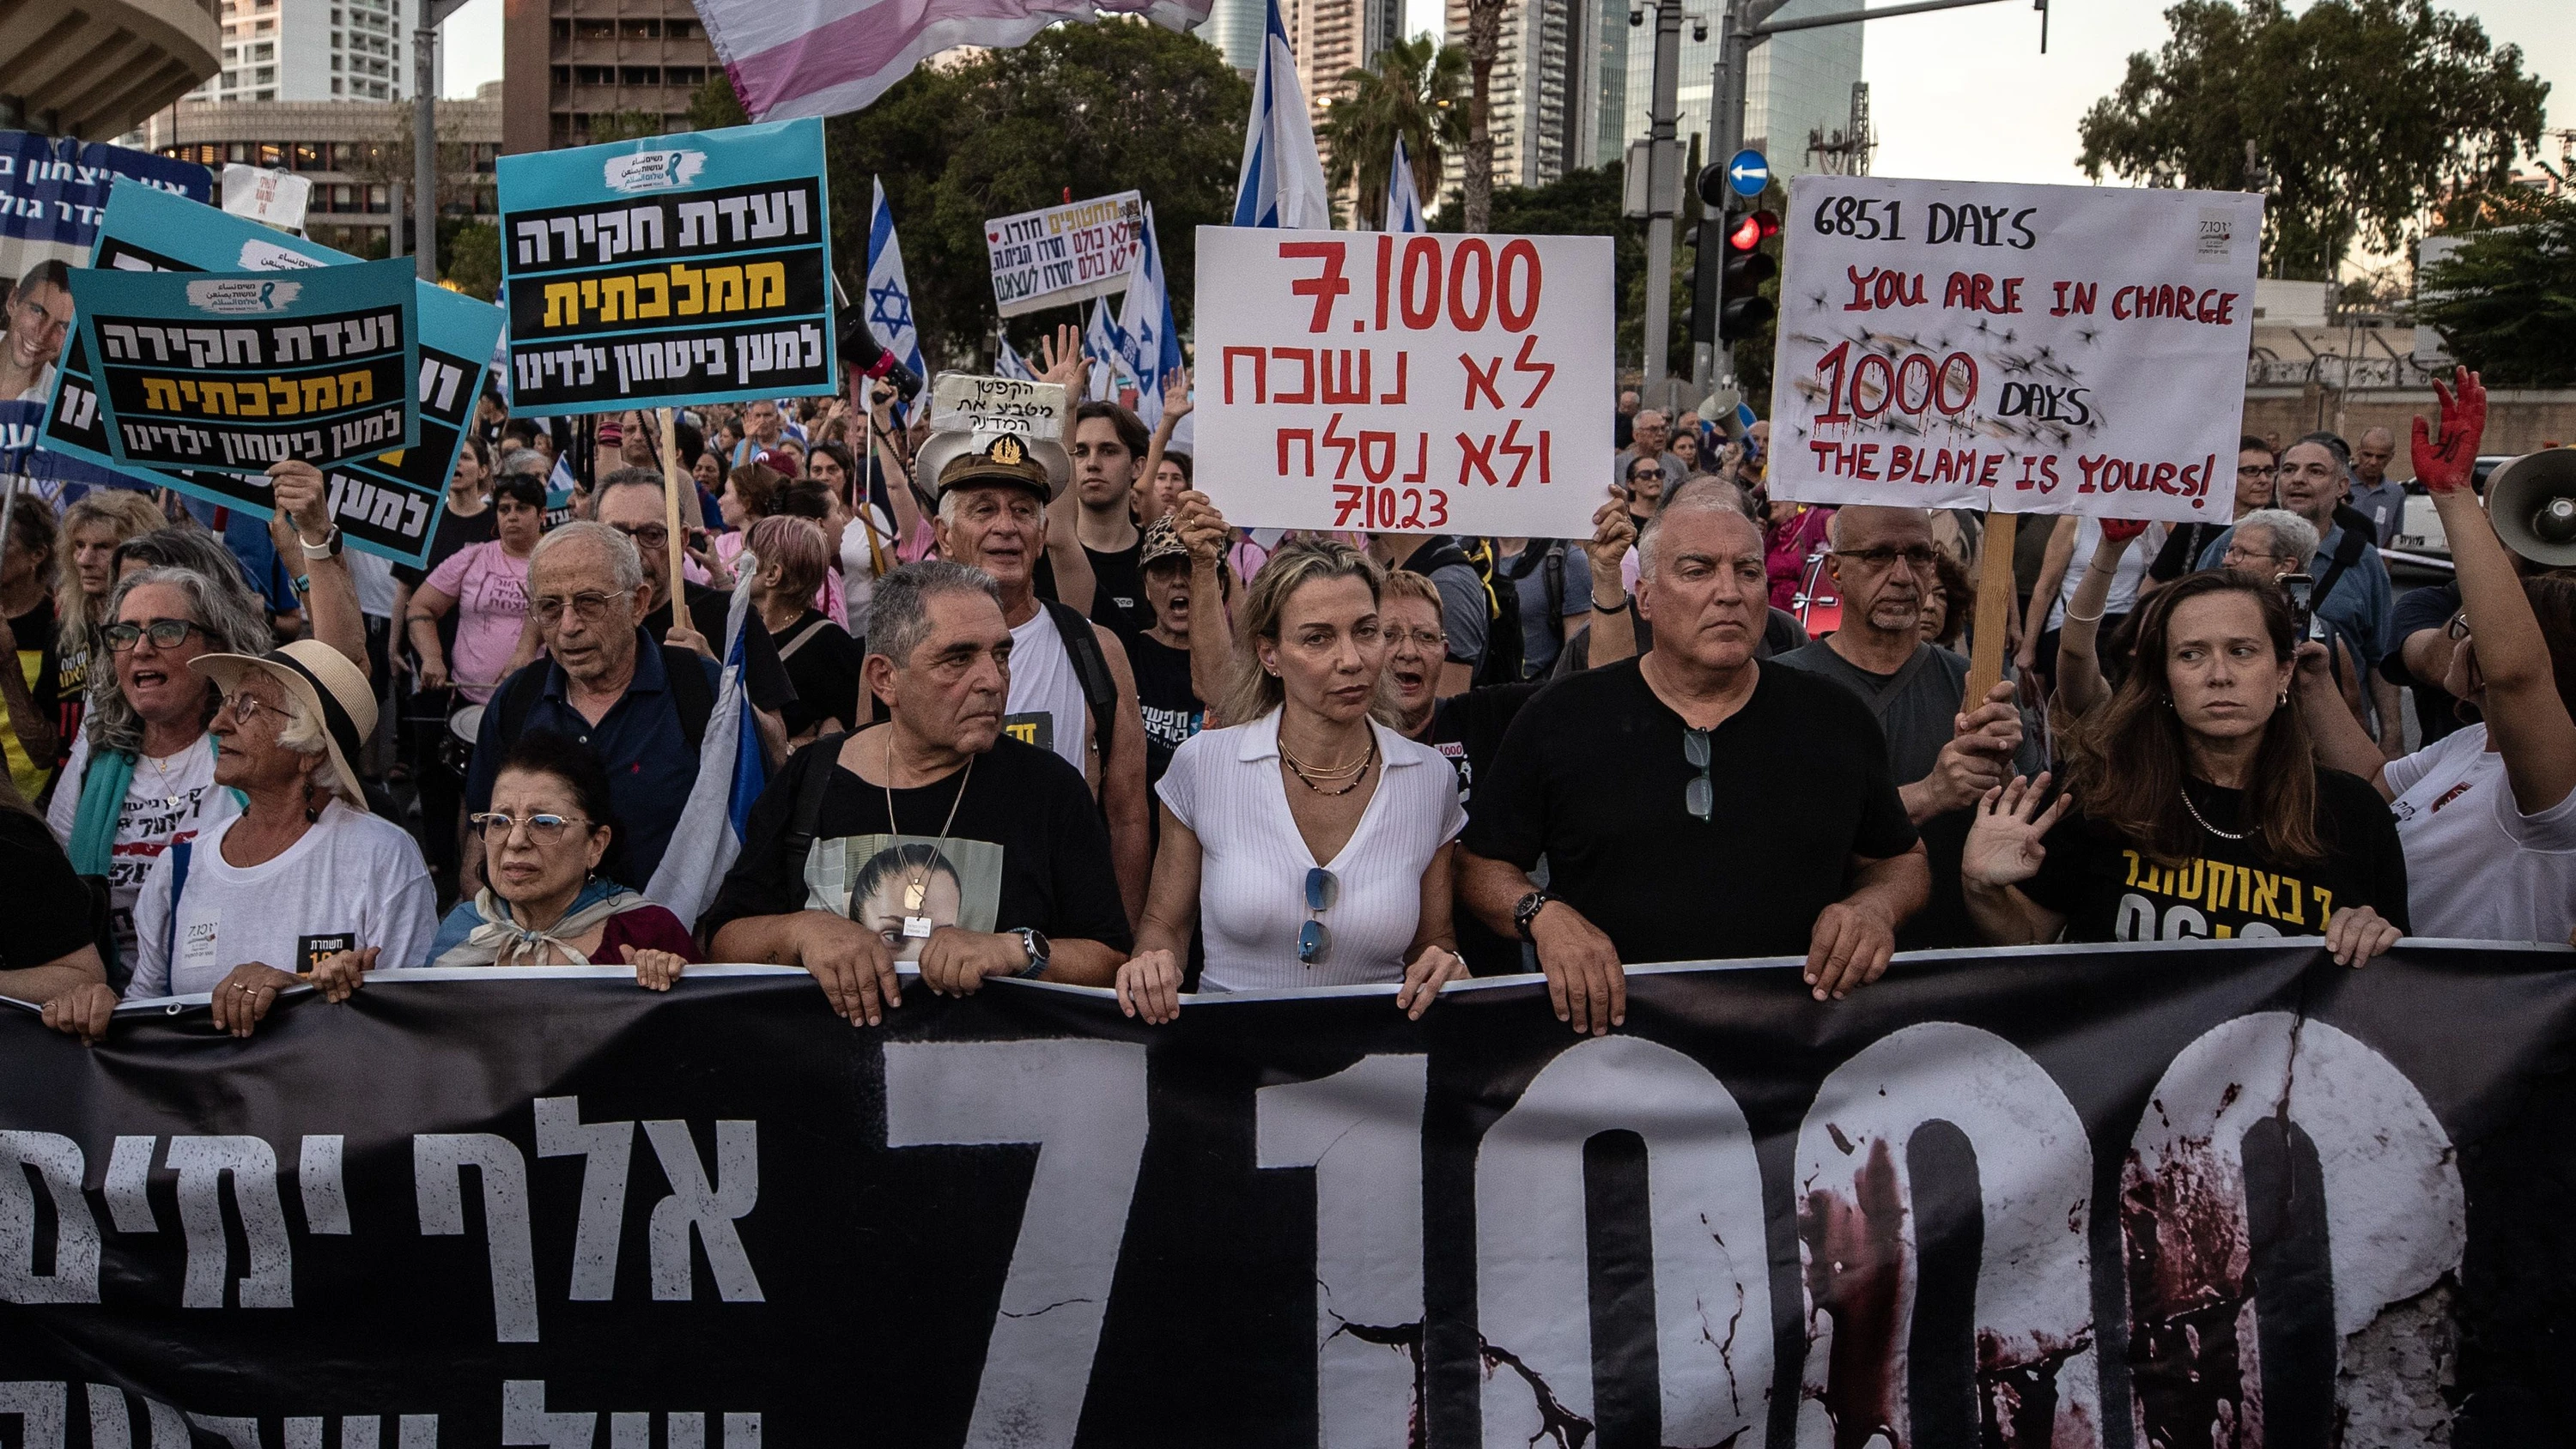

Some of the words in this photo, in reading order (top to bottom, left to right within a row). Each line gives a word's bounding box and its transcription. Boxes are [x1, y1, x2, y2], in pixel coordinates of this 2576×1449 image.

[27, 158, 117, 186] יצחון
[641, 164, 664, 173] עושות
[646, 155, 663, 163] נשים
[646, 173, 664, 181] שלום
[517, 205, 665, 265] חקירה
[678, 189, 809, 247] ועדת
[1004, 216, 1043, 246] חזרו.
[1048, 200, 1118, 235] החטופים
[1108, 221, 1131, 246] לא
[1814, 196, 1906, 241] 6851
[1926, 203, 2038, 251] DAYS
[1036, 235, 1066, 261] חזרו
[1072, 227, 1105, 254] כולם
[1110, 245, 1127, 273] לא
[994, 264, 1039, 301] לעצמם
[1043, 259, 1074, 289] יחזרו
[1078, 252, 1106, 281] כולם
[1279, 234, 1542, 333] 7.1000
[544, 261, 786, 328] ממלכתית
[1943, 270, 2026, 316] ARE
[2050, 280, 2099, 317] IN
[2111, 284, 2239, 326] CHARGE
[103, 324, 261, 368] חקירה
[273, 313, 395, 363] ועדת
[736, 324, 822, 385] למען
[515, 343, 607, 391] ילדינו
[614, 337, 727, 394] ביטחון
[1223, 346, 1408, 405] נשכח
[1458, 334, 1556, 411] לא
[1814, 340, 1979, 425] 1000
[1997, 380, 2091, 427] DAYS
[142, 369, 374, 415] ממלכתית
[956, 398, 987, 412] את
[975, 379, 1034, 400] הקפטן
[995, 402, 1054, 418] מטביע
[123, 423, 212, 455] ילדינו
[331, 409, 400, 458] למען
[969, 415, 1030, 431] המדינה
[219, 429, 324, 465] ביטחון
[1276, 412, 1429, 485] נסלח
[1455, 419, 1552, 488] ולא
[1809, 440, 1880, 482] THE
[1886, 441, 2005, 488] BLAME
[2016, 455, 2059, 494] IS
[2077, 453, 2216, 509] YOURS!
[326, 472, 429, 538] למען
[1333, 483, 1449, 530] 7.10.23
[1142, 718, 1188, 743] בארצנ
[310, 937, 343, 950] משמרת
[0, 1130, 352, 1309] ימים
[413, 1095, 766, 1343] אלף
